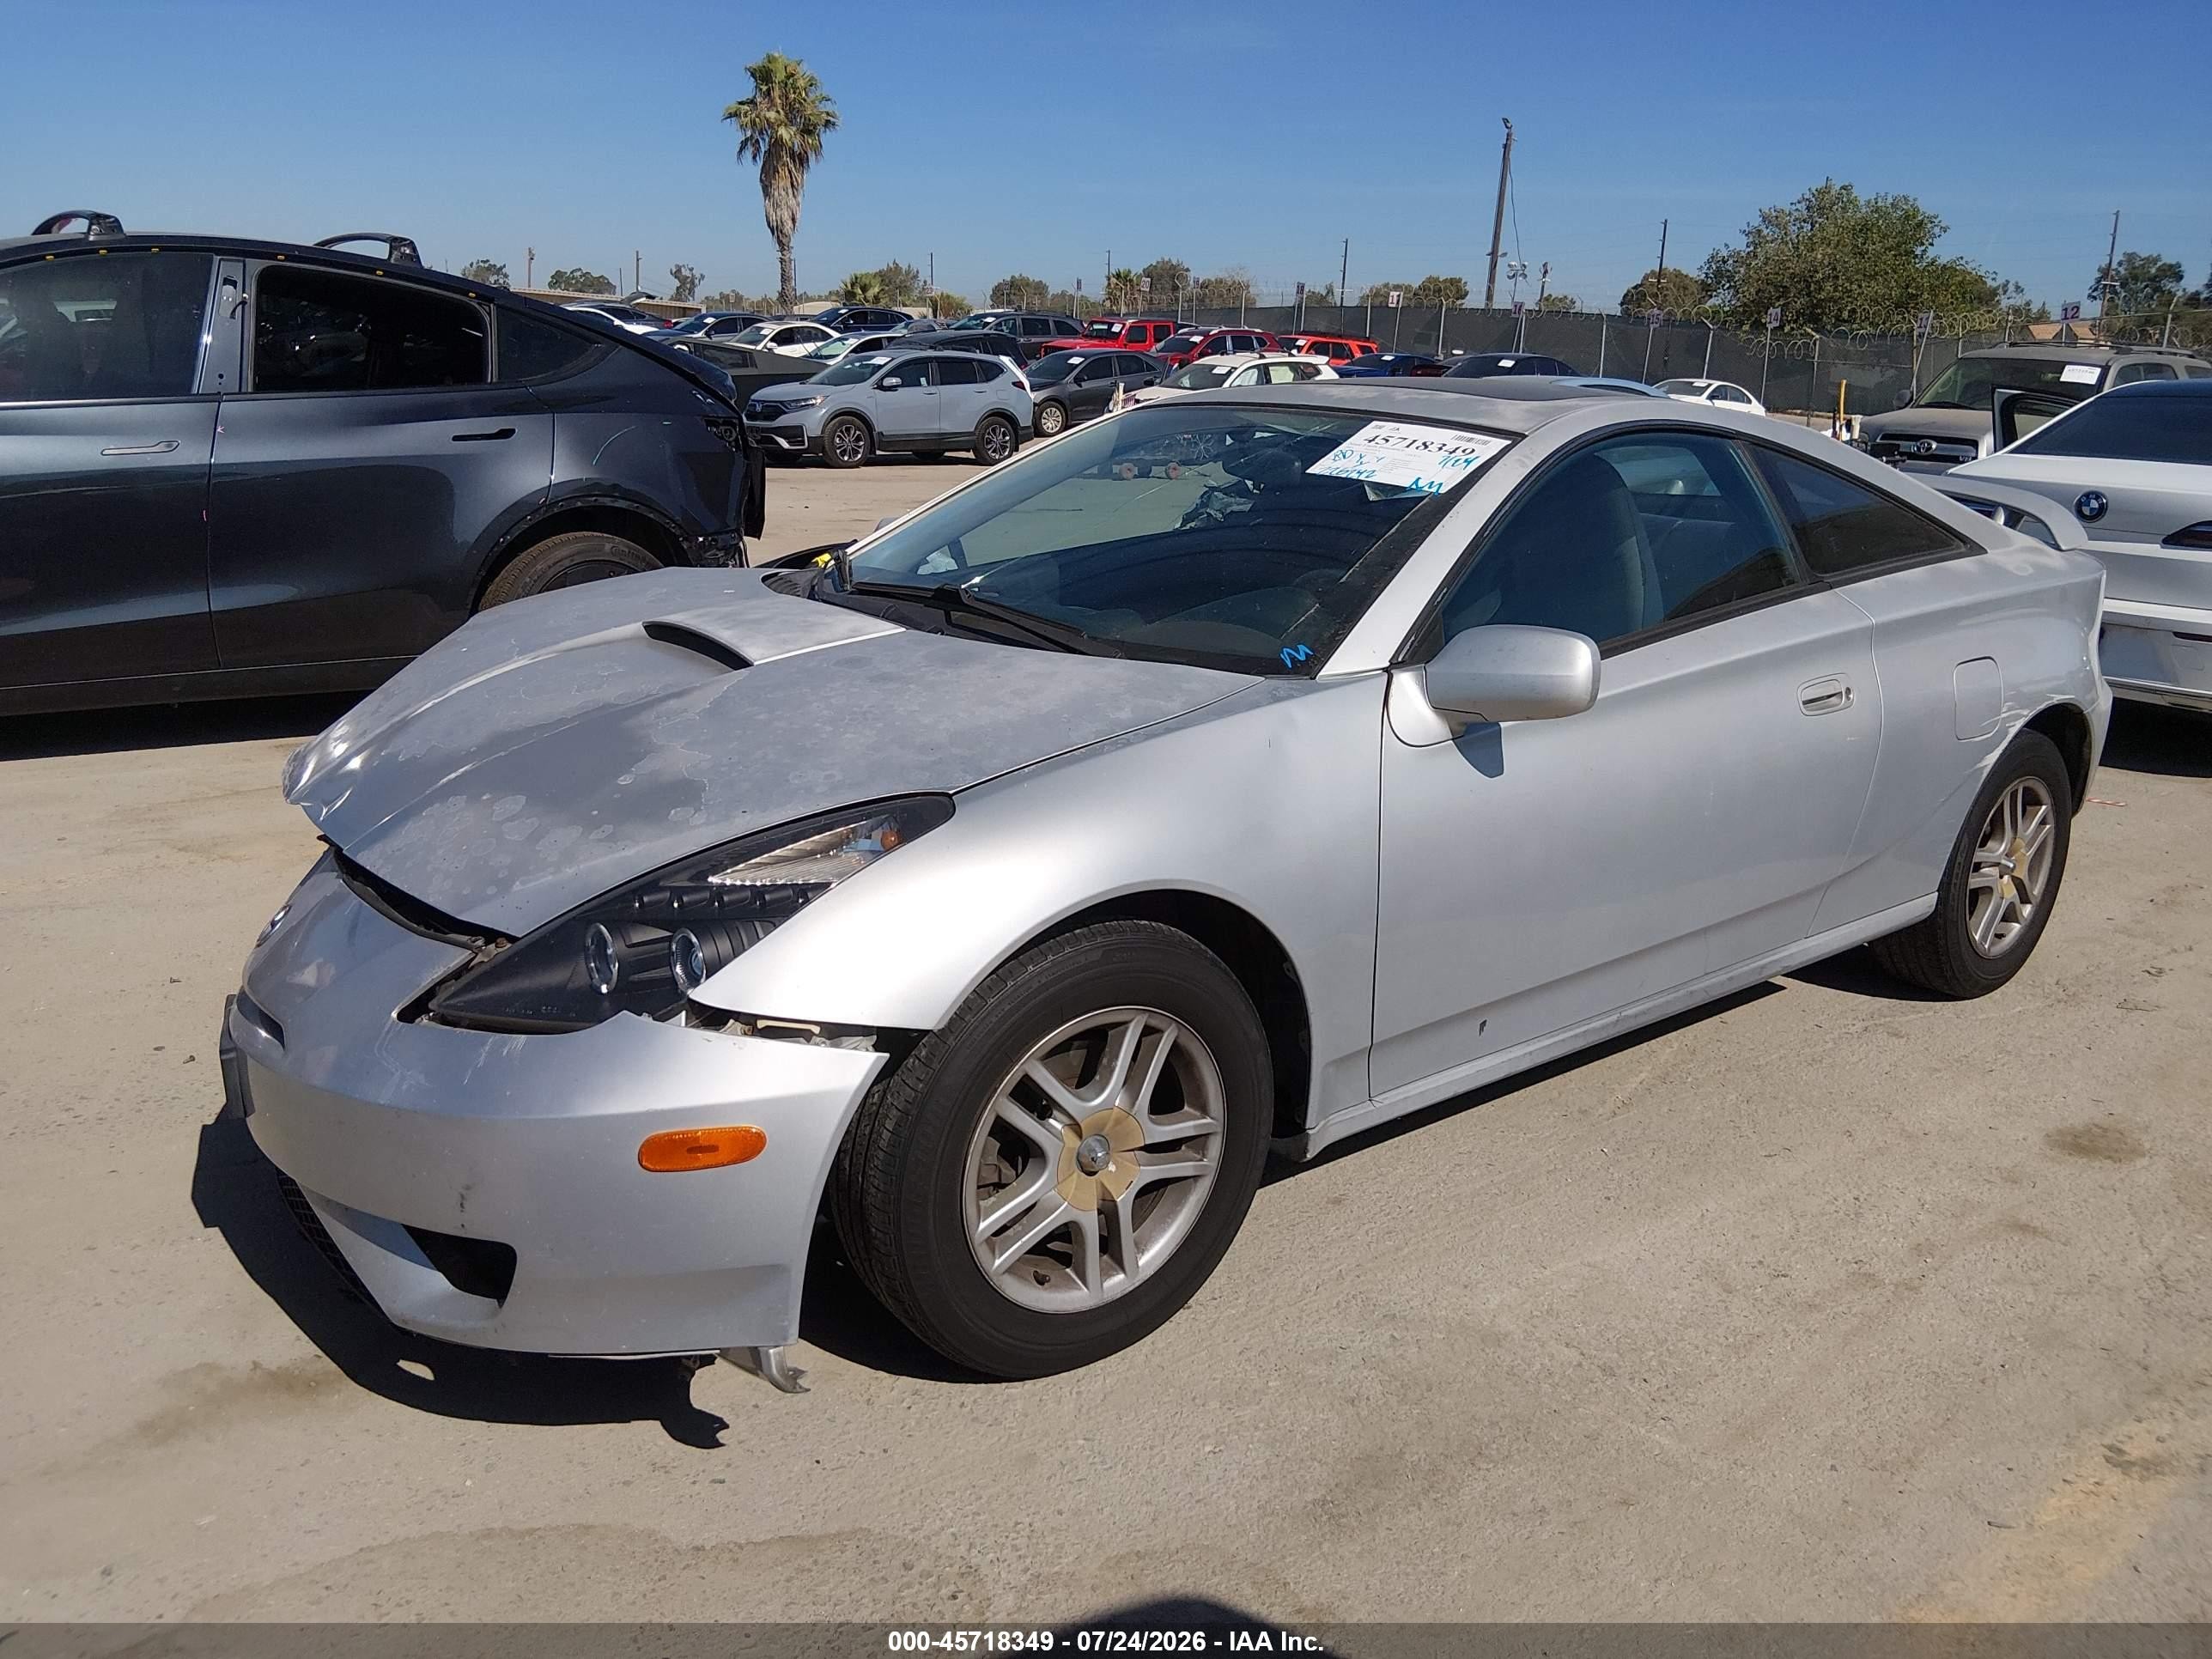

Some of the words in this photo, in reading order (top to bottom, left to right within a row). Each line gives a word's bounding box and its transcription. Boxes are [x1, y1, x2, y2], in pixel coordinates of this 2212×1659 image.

[1141, 280, 1150, 289] 20
[1297, 285, 1304, 295] 18
[1650, 313, 1661, 324] 15
[1769, 312, 1779, 324] 14
[2061, 306, 2080, 320] 12
[1363, 434, 1476, 457] 45718349
